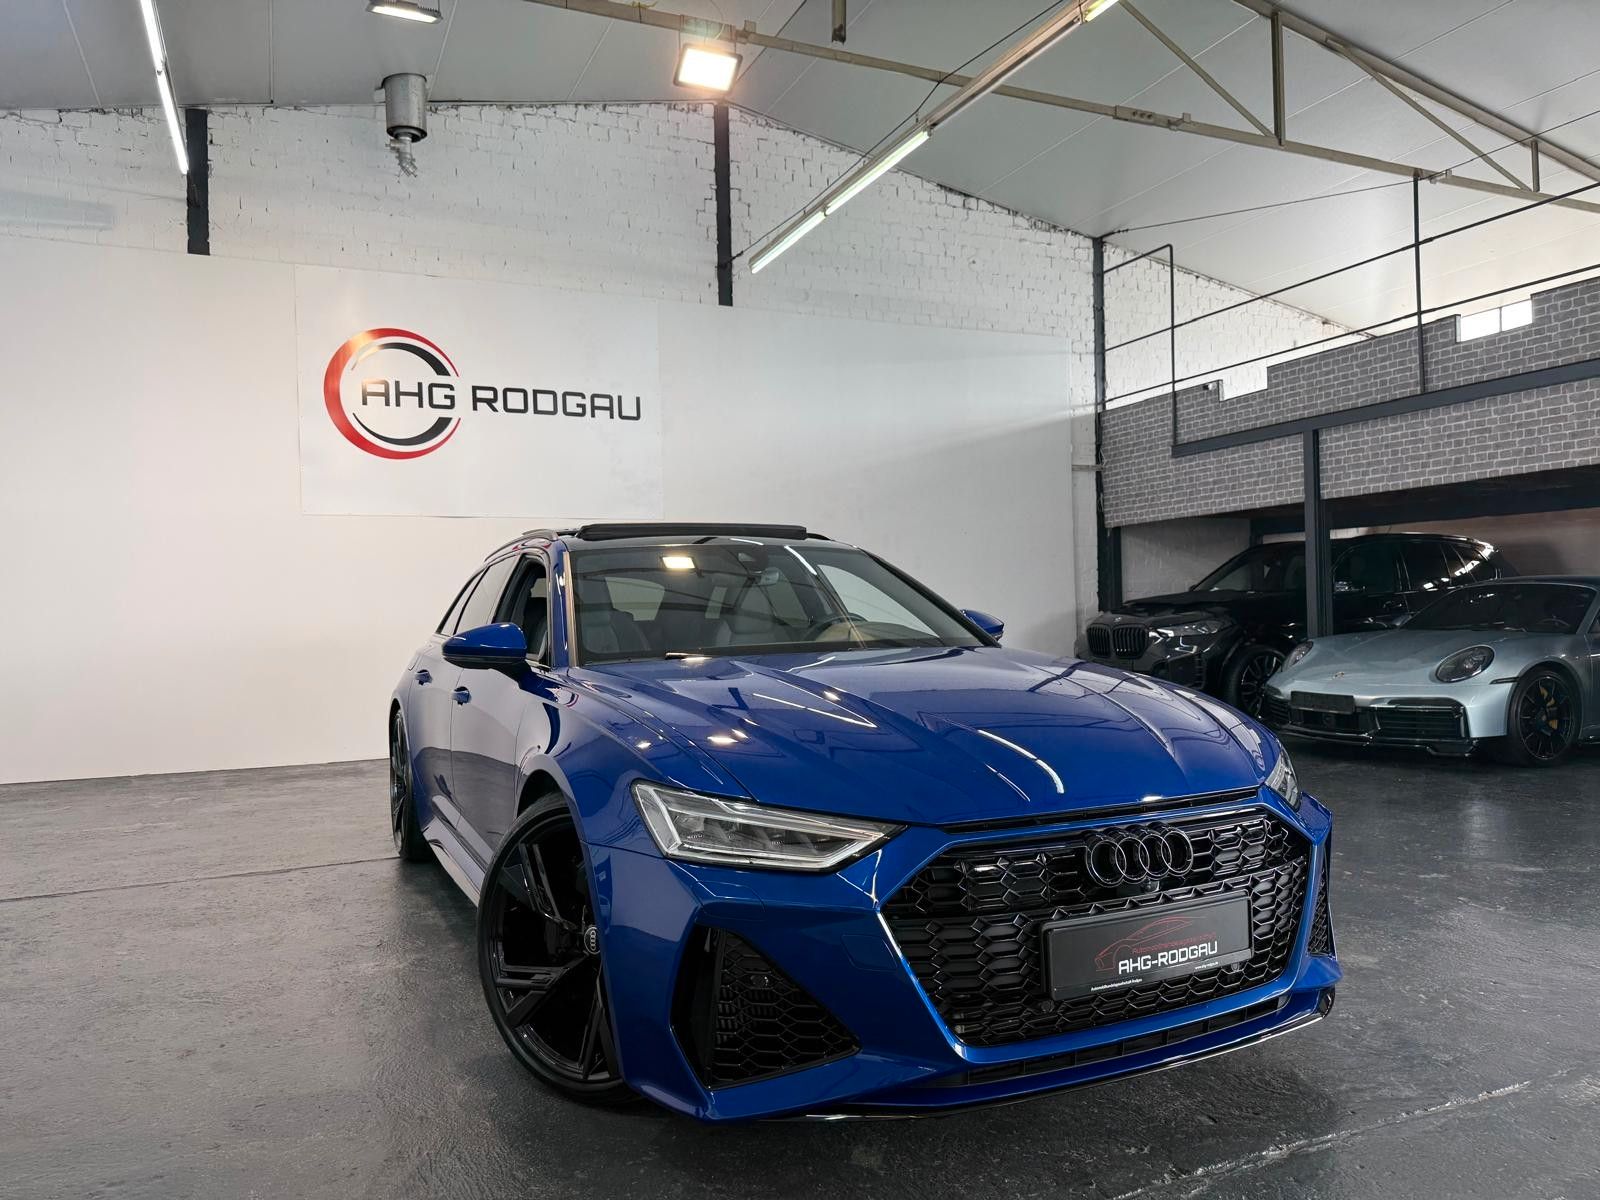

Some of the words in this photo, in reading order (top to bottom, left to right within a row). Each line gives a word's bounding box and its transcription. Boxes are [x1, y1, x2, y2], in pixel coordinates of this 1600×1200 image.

[361, 378, 456, 410] AHG
[471, 385, 641, 421] RODGAU
[1118, 940, 1218, 975] AHG-RODGAU
